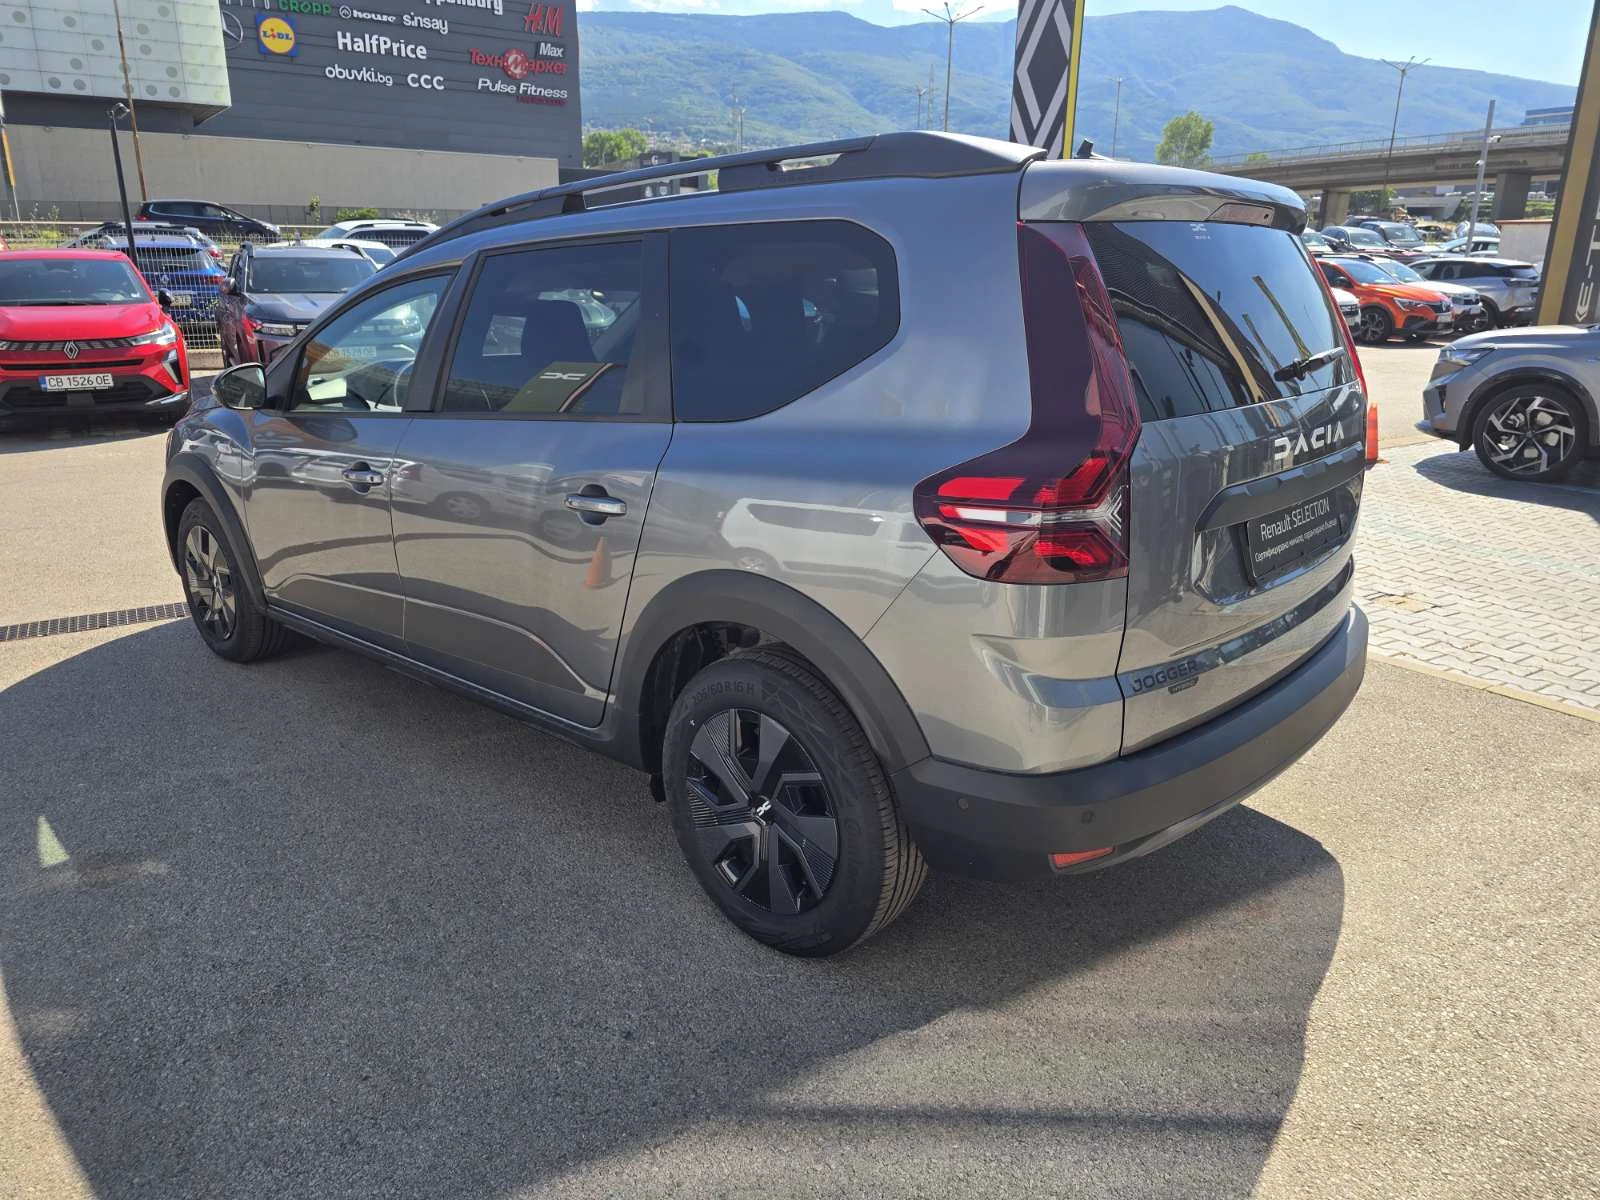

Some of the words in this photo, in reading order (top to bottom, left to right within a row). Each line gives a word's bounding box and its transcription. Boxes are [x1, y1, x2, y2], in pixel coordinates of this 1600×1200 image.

[277, 0, 332, 15] CROPP
[524, 0, 563, 37] H&M
[352, 9, 396, 23] house
[402, 12, 449, 35] sinsay
[337, 31, 427, 59] HalfPrice
[539, 42, 564, 57] Max
[325, 63, 393, 87] obuvki.bg
[407, 73, 445, 90] CCC
[478, 77, 517, 94] Pulse
[519, 82, 568, 98] Fitness
[48, 377, 64, 388] CB
[67, 375, 94, 387] 1526
[1273, 420, 1345, 461] DACIA
[1260, 513, 1293, 541] Renault
[1291, 497, 1330, 528] SELECTION
[1132, 660, 1198, 693] JOGGER
